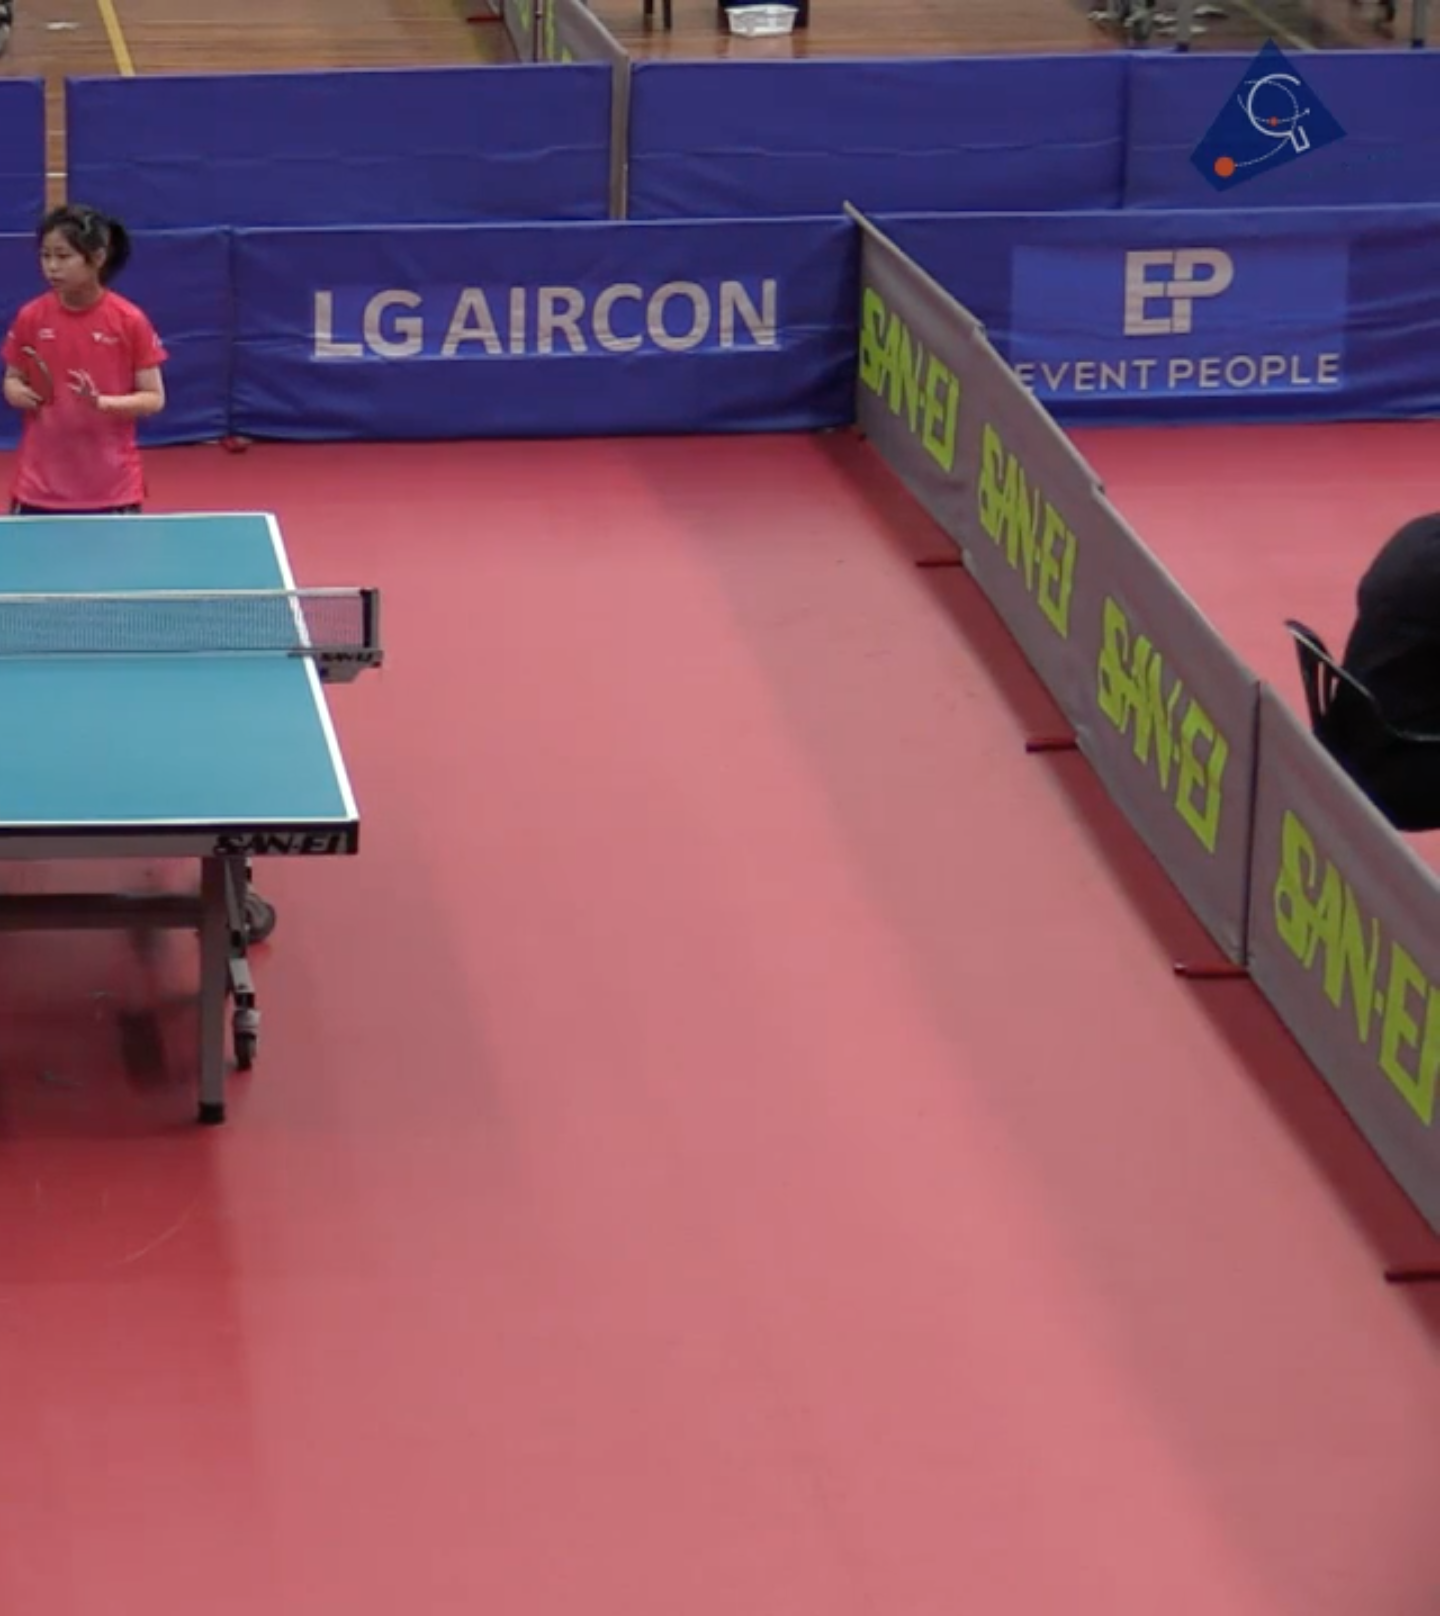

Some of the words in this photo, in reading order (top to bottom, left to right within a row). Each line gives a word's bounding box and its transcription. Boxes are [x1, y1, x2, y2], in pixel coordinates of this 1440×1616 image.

[314, 290, 424, 358] LG
[442, 278, 777, 356] AIRCON
[1123, 248, 1234, 337] EP
[860, 288, 959, 475] SAN-EI
[1168, 353, 1340, 388] PEOPLE
[978, 423, 1077, 639] SAN-EI
[1098, 596, 1229, 853] SAN-EI
